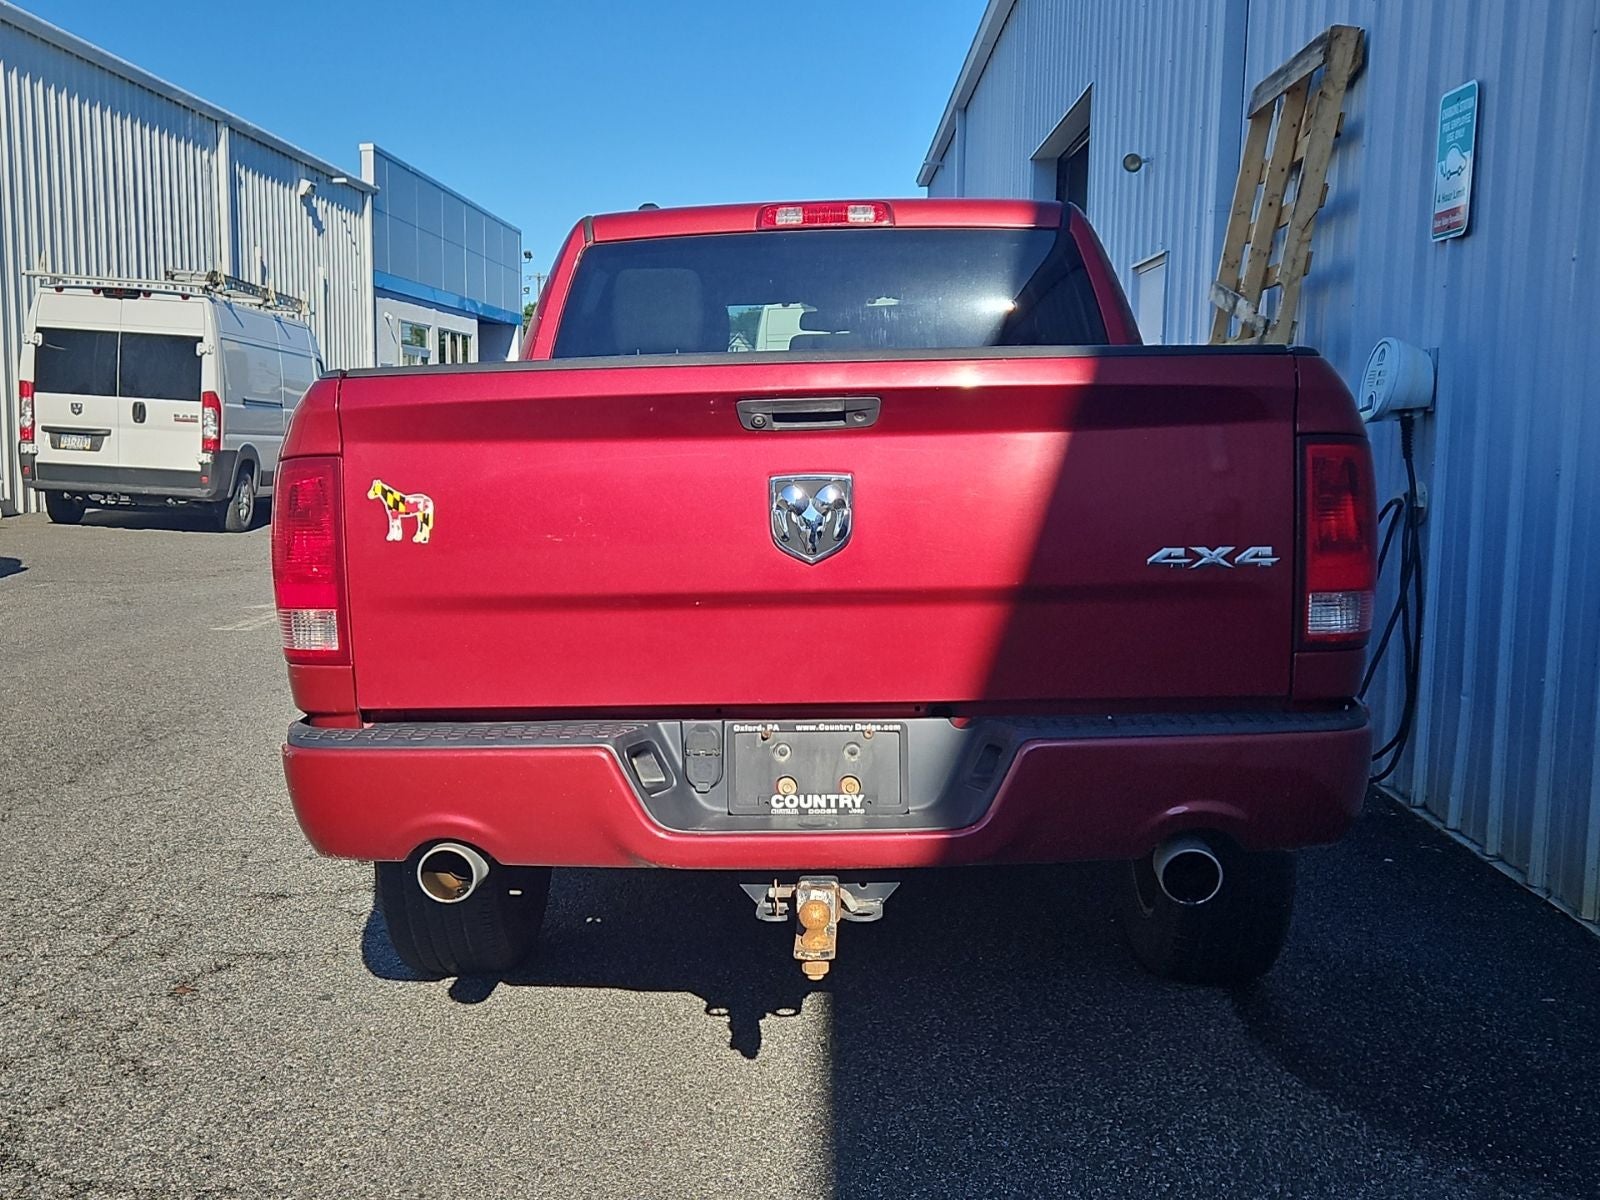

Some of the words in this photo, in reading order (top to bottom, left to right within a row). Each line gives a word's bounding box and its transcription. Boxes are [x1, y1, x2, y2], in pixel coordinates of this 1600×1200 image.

[1146, 546, 1281, 569] 4X4
[767, 723, 780, 731] PA
[854, 723, 902, 732] Dodge.com
[770, 794, 865, 809] COUNTRY
